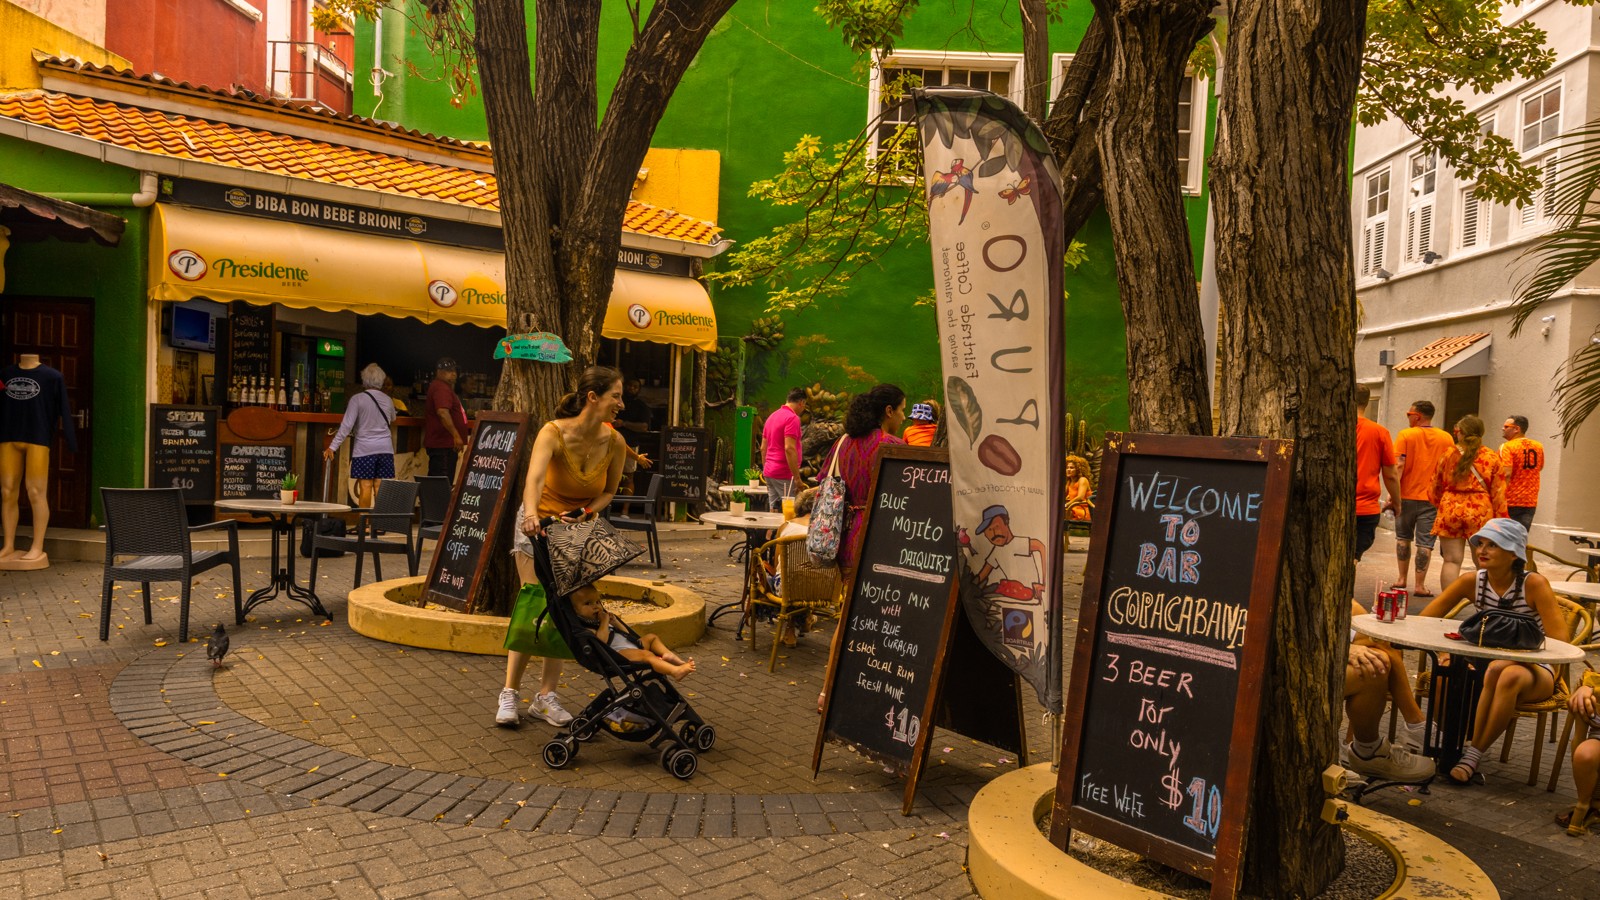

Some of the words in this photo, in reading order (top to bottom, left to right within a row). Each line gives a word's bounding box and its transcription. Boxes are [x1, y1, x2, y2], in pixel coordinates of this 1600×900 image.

[229, 194, 247, 202] BRION
[255, 194, 287, 214] BIBA
[291, 200, 319, 218] BON
[323, 205, 355, 224] BEBE
[359, 211, 401, 230] BRION!
[618, 250, 643, 265] RION!
[212, 258, 309, 281] Presidente
[654, 310, 713, 328] Presidente
[162, 438, 199, 446] BANANA
[1523, 449, 1537, 470] 10
[461, 492, 481, 506] BEER
[880, 493, 909, 511] BLUE
[1128, 471, 1262, 522] WELCOME
[1160, 514, 1200, 547] TO
[899, 548, 952, 573] DAIQUIRI
[1136, 543, 1201, 584] BAR
[908, 592, 930, 610] MIX
[851, 616, 858, 631] 1
[881, 620, 901, 637] BLUE
[1108, 586, 1249, 649] COPACABANA
[848, 640, 854, 652] 1
[867, 657, 892, 674] LOCAL
[896, 665, 915, 684] RUM
[1102, 653, 1120, 682] 3
[1128, 660, 1194, 698] BEER
[885, 705, 921, 747] $10
